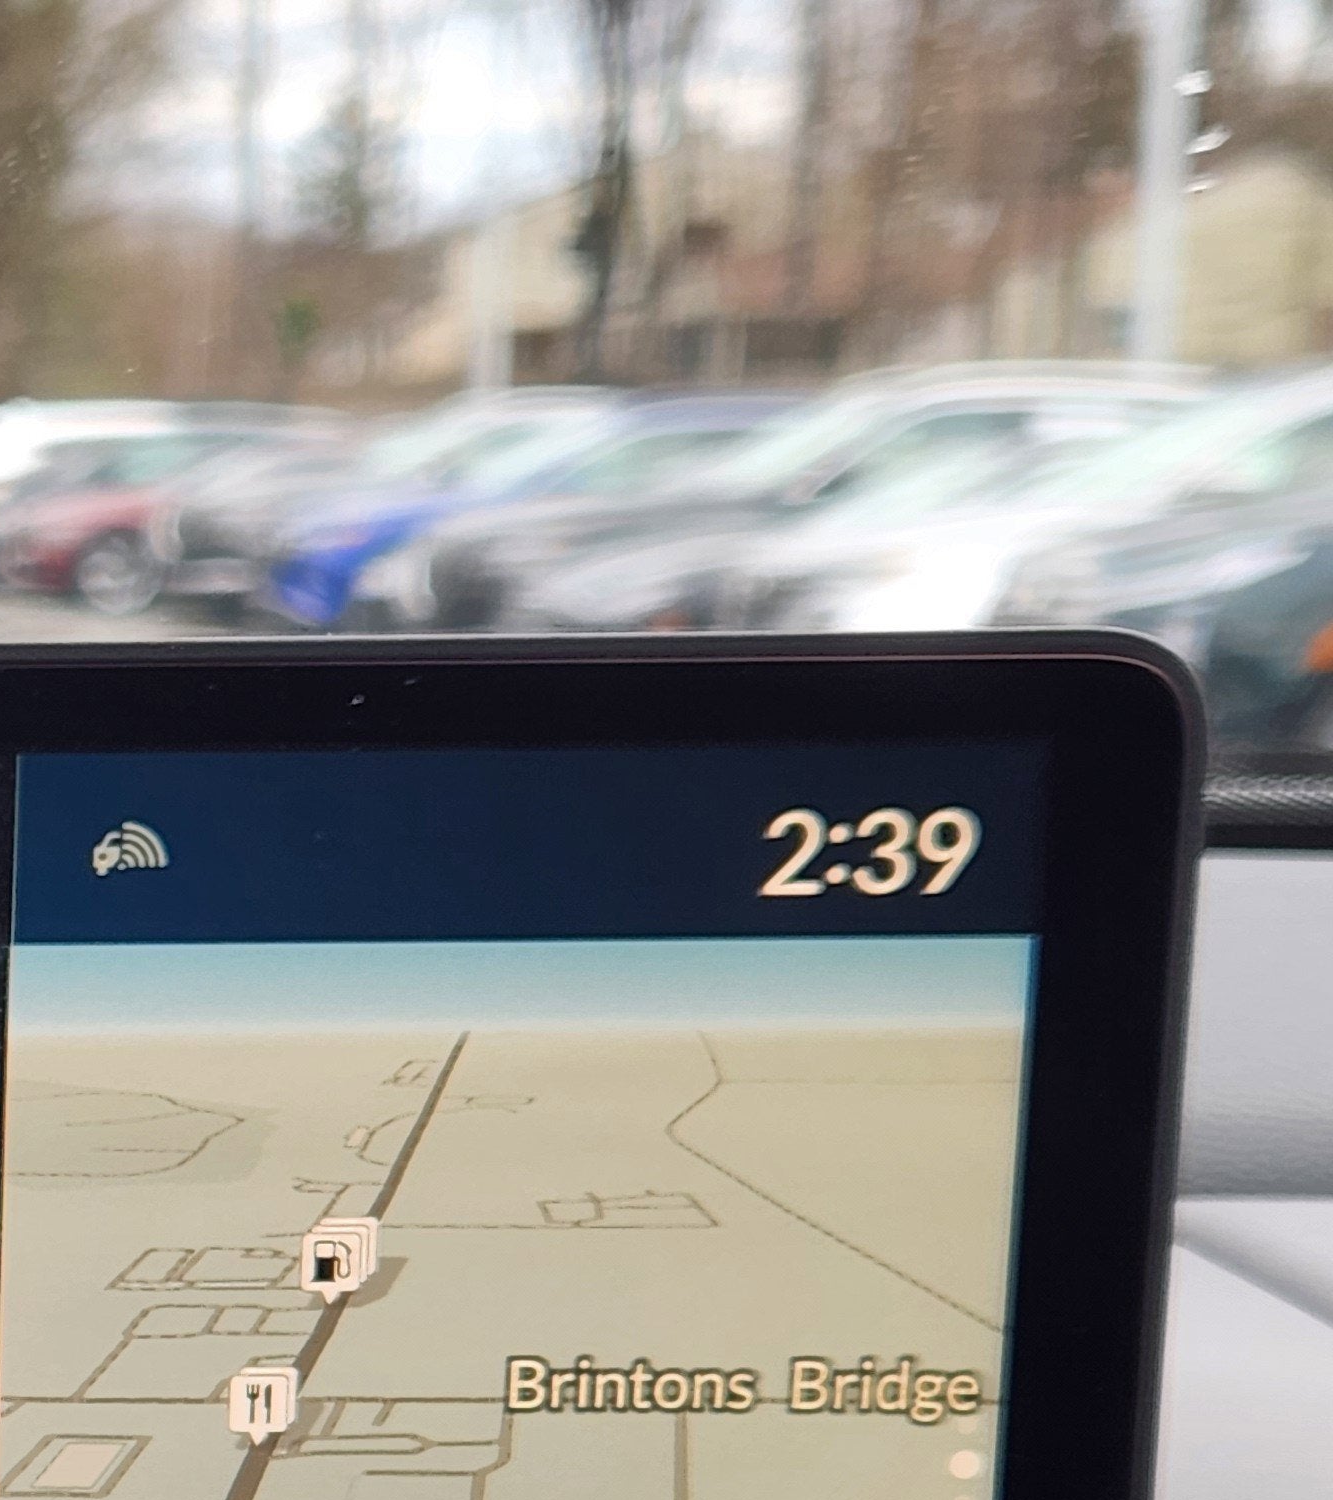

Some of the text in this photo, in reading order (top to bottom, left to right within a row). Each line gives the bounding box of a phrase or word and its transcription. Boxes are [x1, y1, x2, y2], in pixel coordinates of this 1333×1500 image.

[757, 805, 981, 898] 2:39
[507, 1355, 983, 1420] Brintons Bridge
